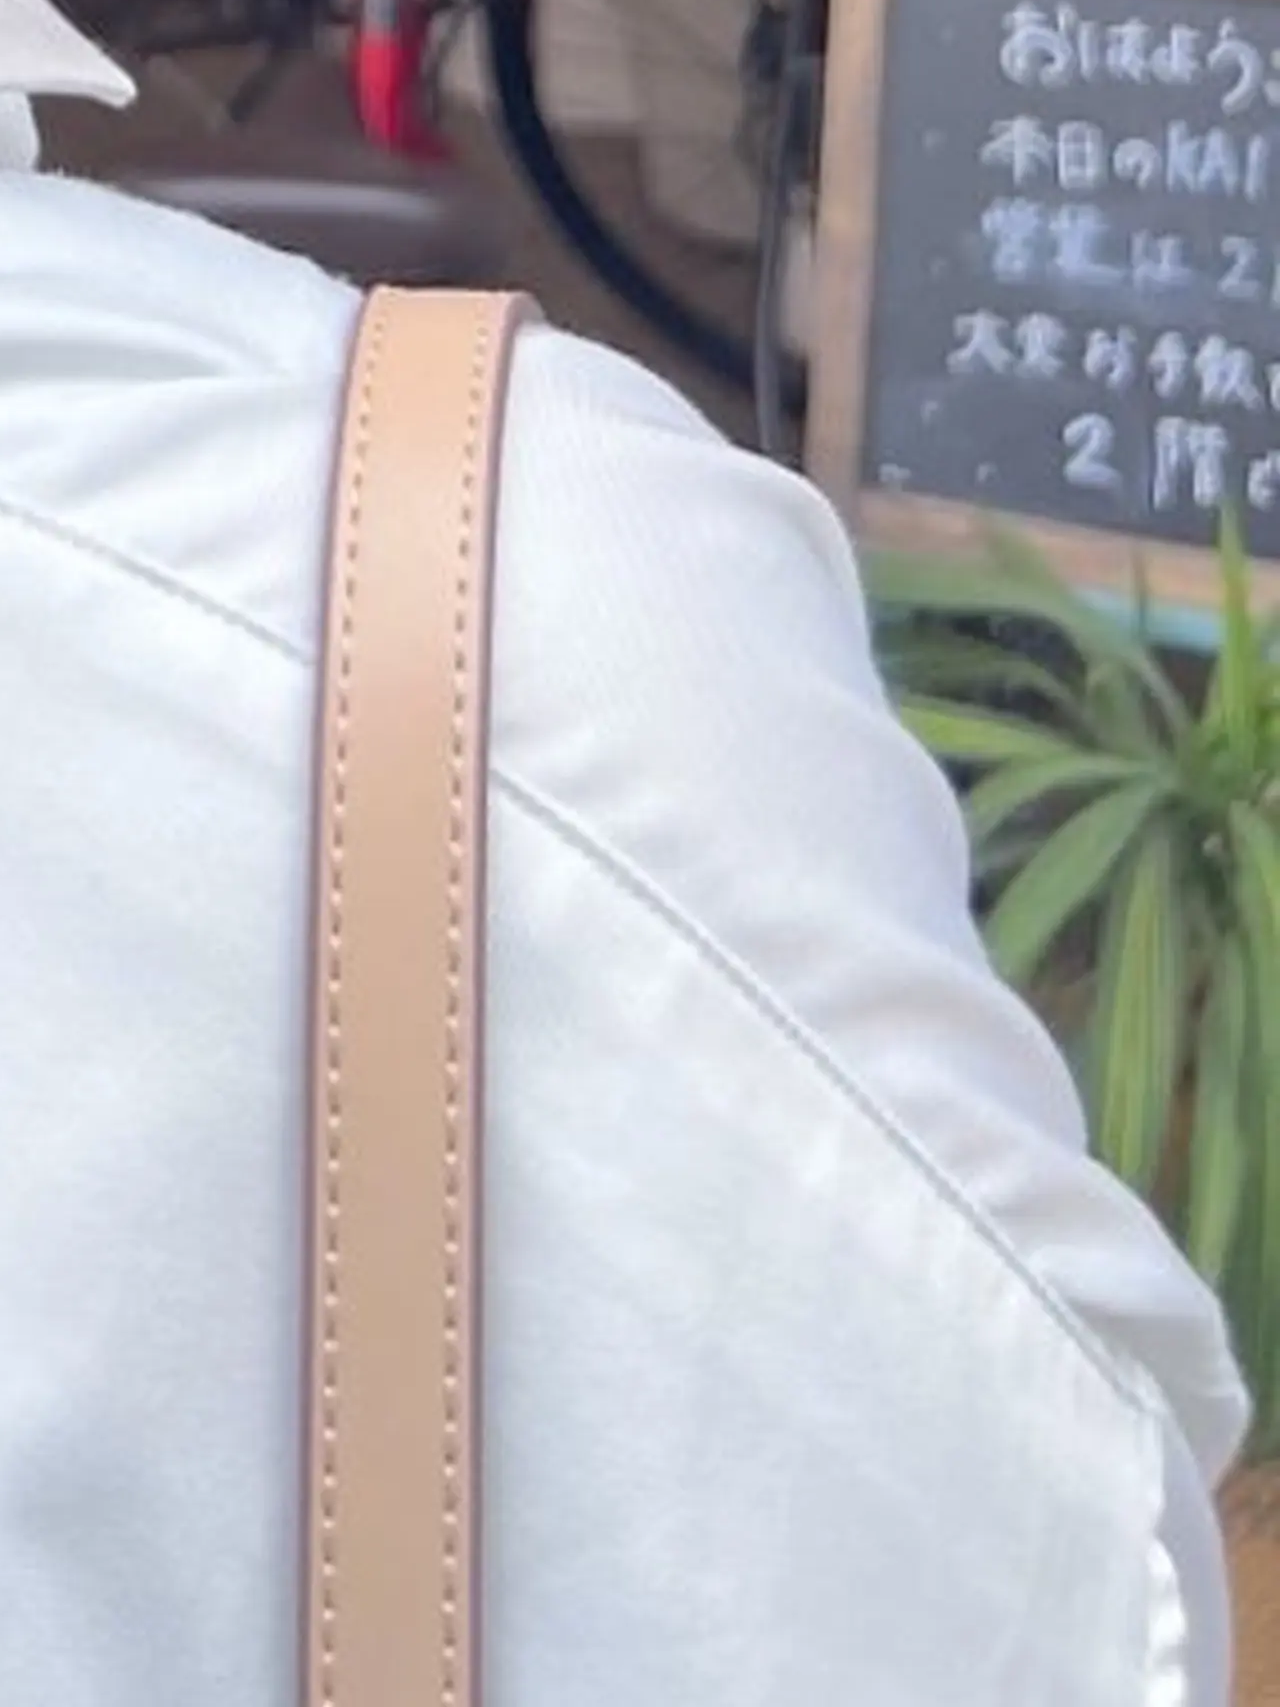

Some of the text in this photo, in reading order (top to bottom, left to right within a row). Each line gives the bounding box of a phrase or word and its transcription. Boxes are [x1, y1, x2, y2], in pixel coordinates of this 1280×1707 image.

[1000, 0, 1280, 117] おはよう
[980, 196, 1280, 305] 営業は2
